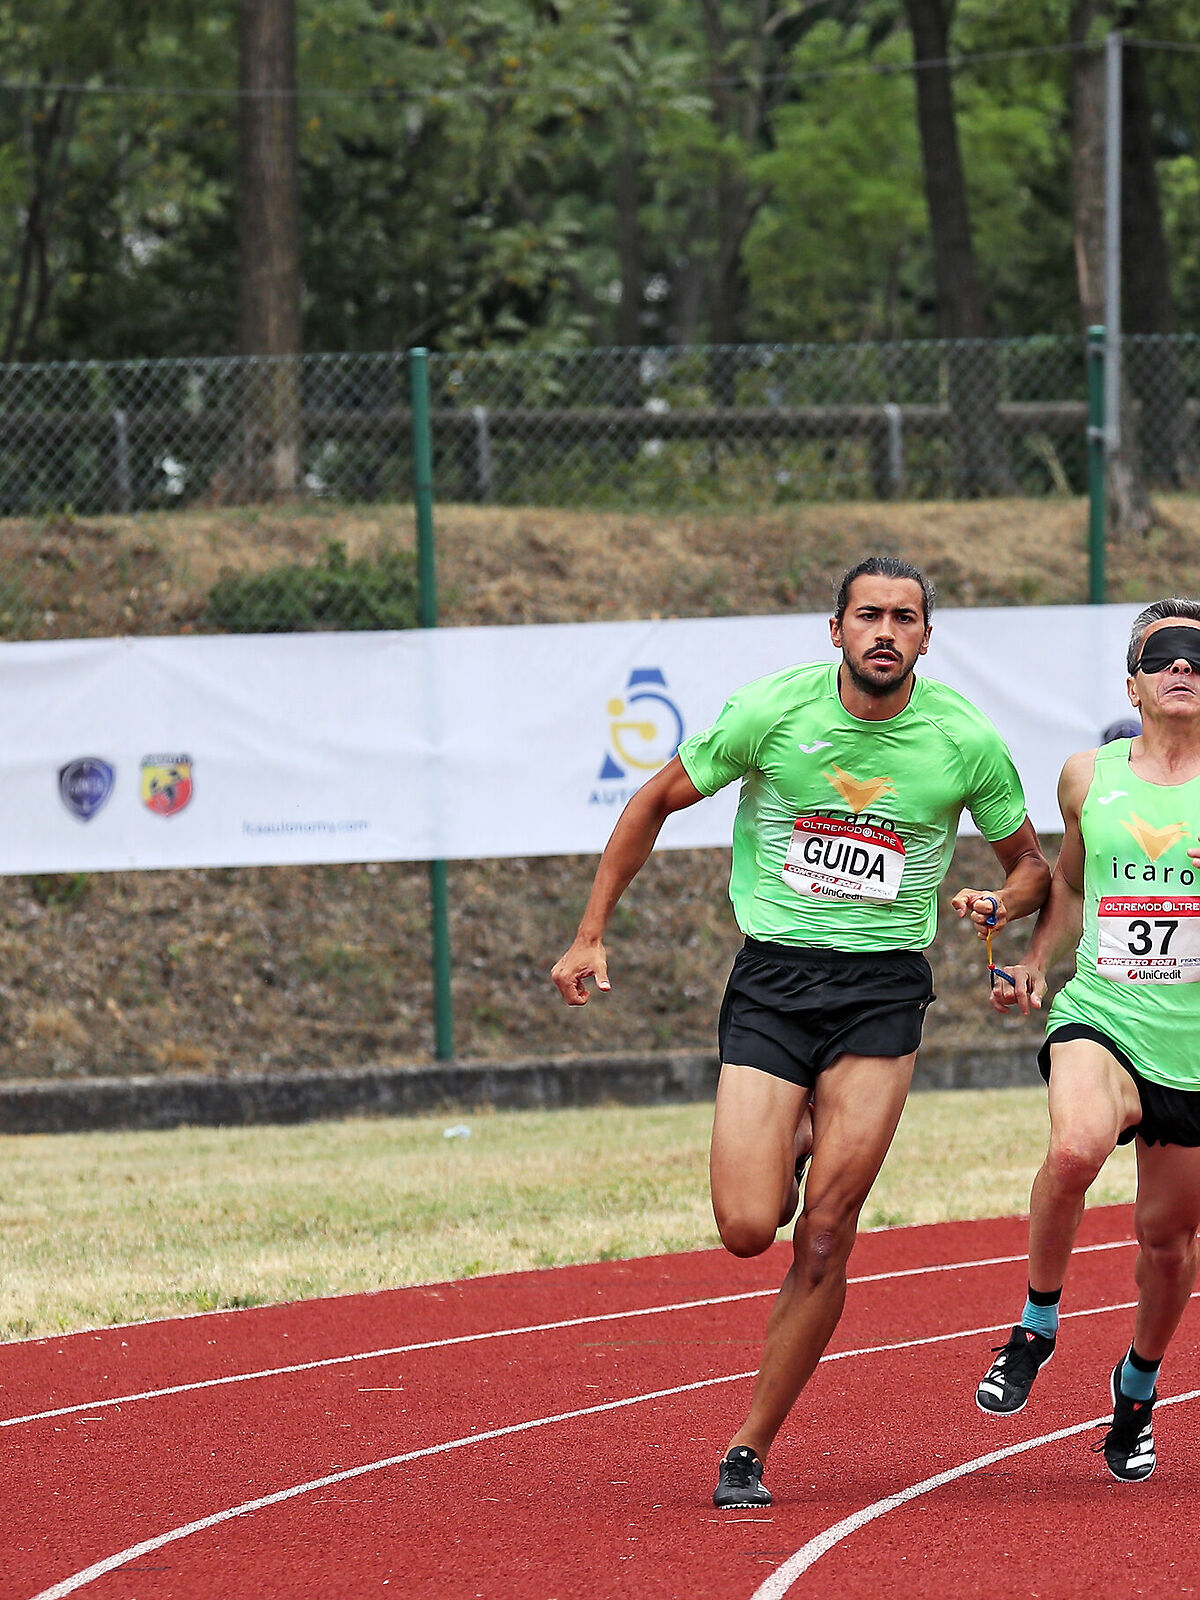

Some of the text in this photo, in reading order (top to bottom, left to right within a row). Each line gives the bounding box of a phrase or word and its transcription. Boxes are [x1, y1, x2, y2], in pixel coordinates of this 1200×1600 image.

[803, 836, 885, 883] GUIDA
[1111, 856, 1195, 886] icaro
[821, 885, 863, 900] UniCredit
[1127, 919, 1179, 957] 37
[1138, 969, 1182, 981] UniCredit
